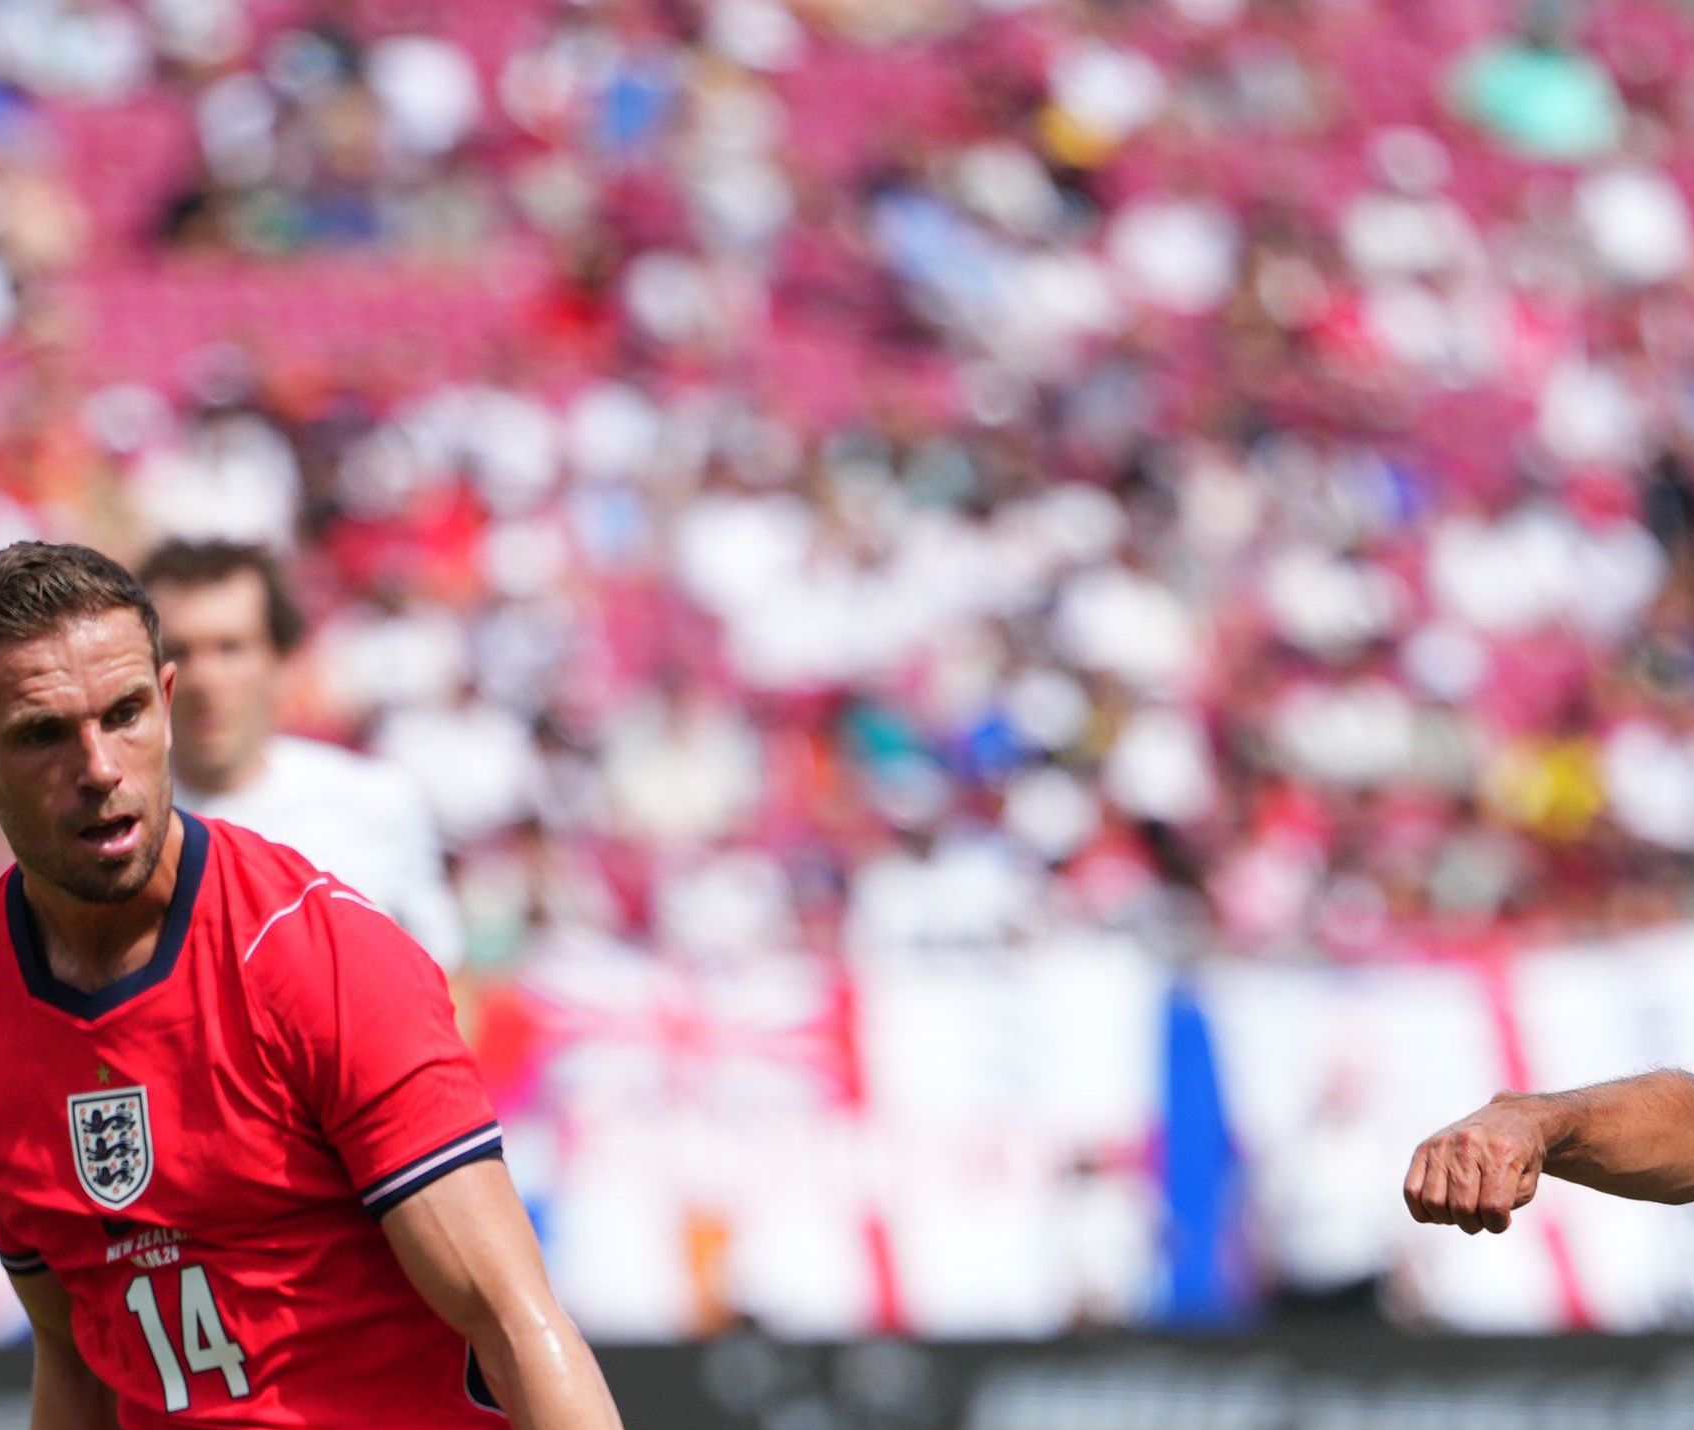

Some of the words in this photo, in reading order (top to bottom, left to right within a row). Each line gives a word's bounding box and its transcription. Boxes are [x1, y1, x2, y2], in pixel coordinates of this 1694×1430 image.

[106, 1238, 135, 1263] NEW
[135, 1226, 192, 1251] ZEAL
[126, 1265, 250, 1412] 14
